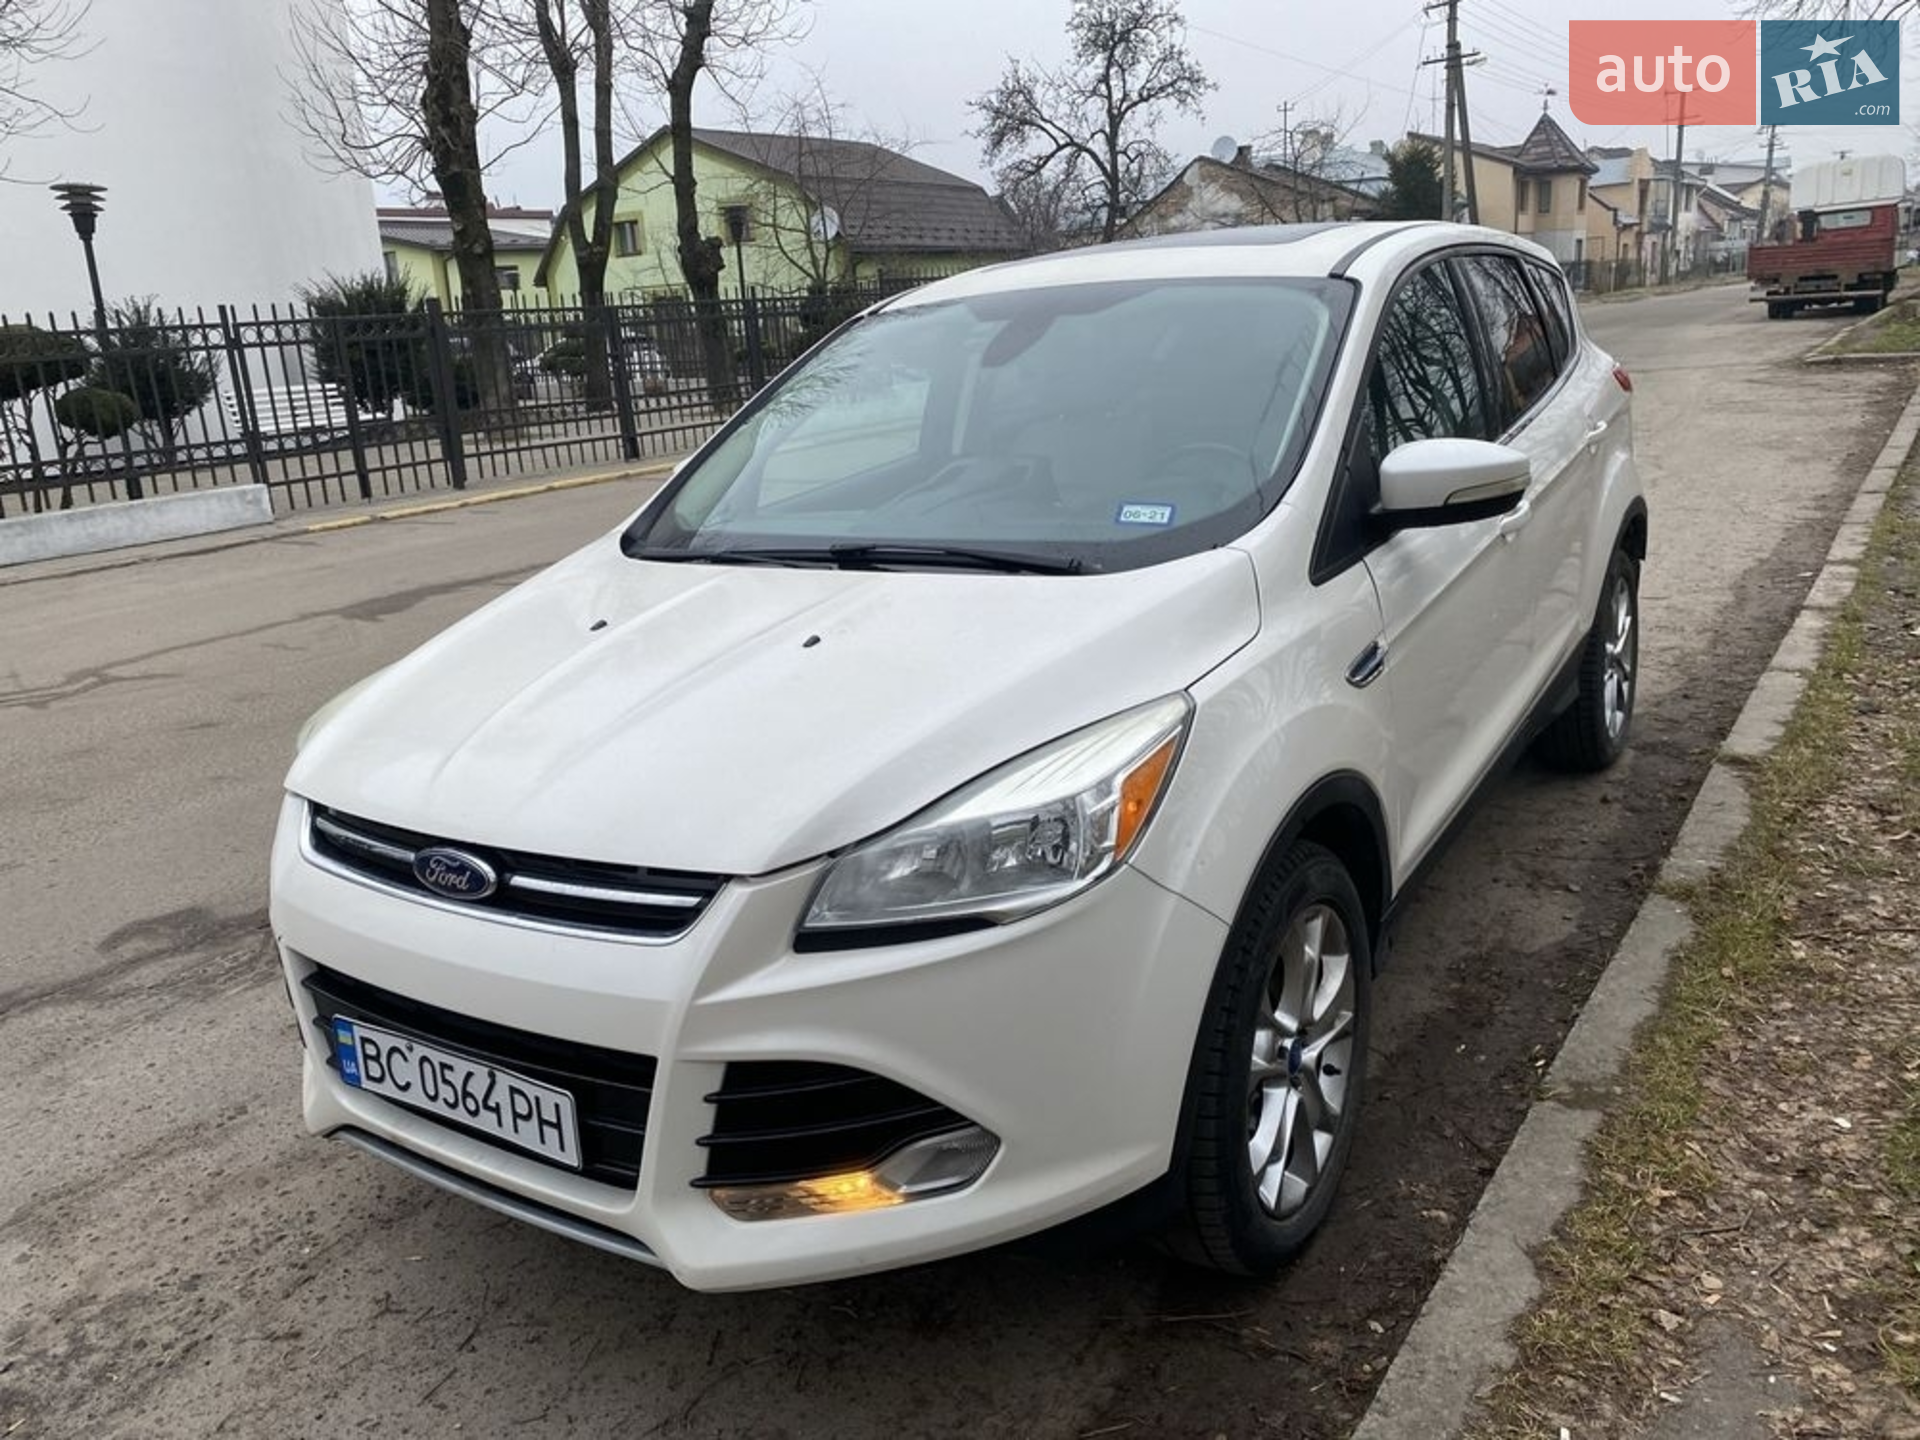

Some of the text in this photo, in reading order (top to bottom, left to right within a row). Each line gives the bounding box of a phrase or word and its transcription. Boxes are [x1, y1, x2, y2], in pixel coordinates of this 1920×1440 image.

[425, 855, 471, 890] Ford
[359, 1035, 566, 1154] BC 0564 PH
